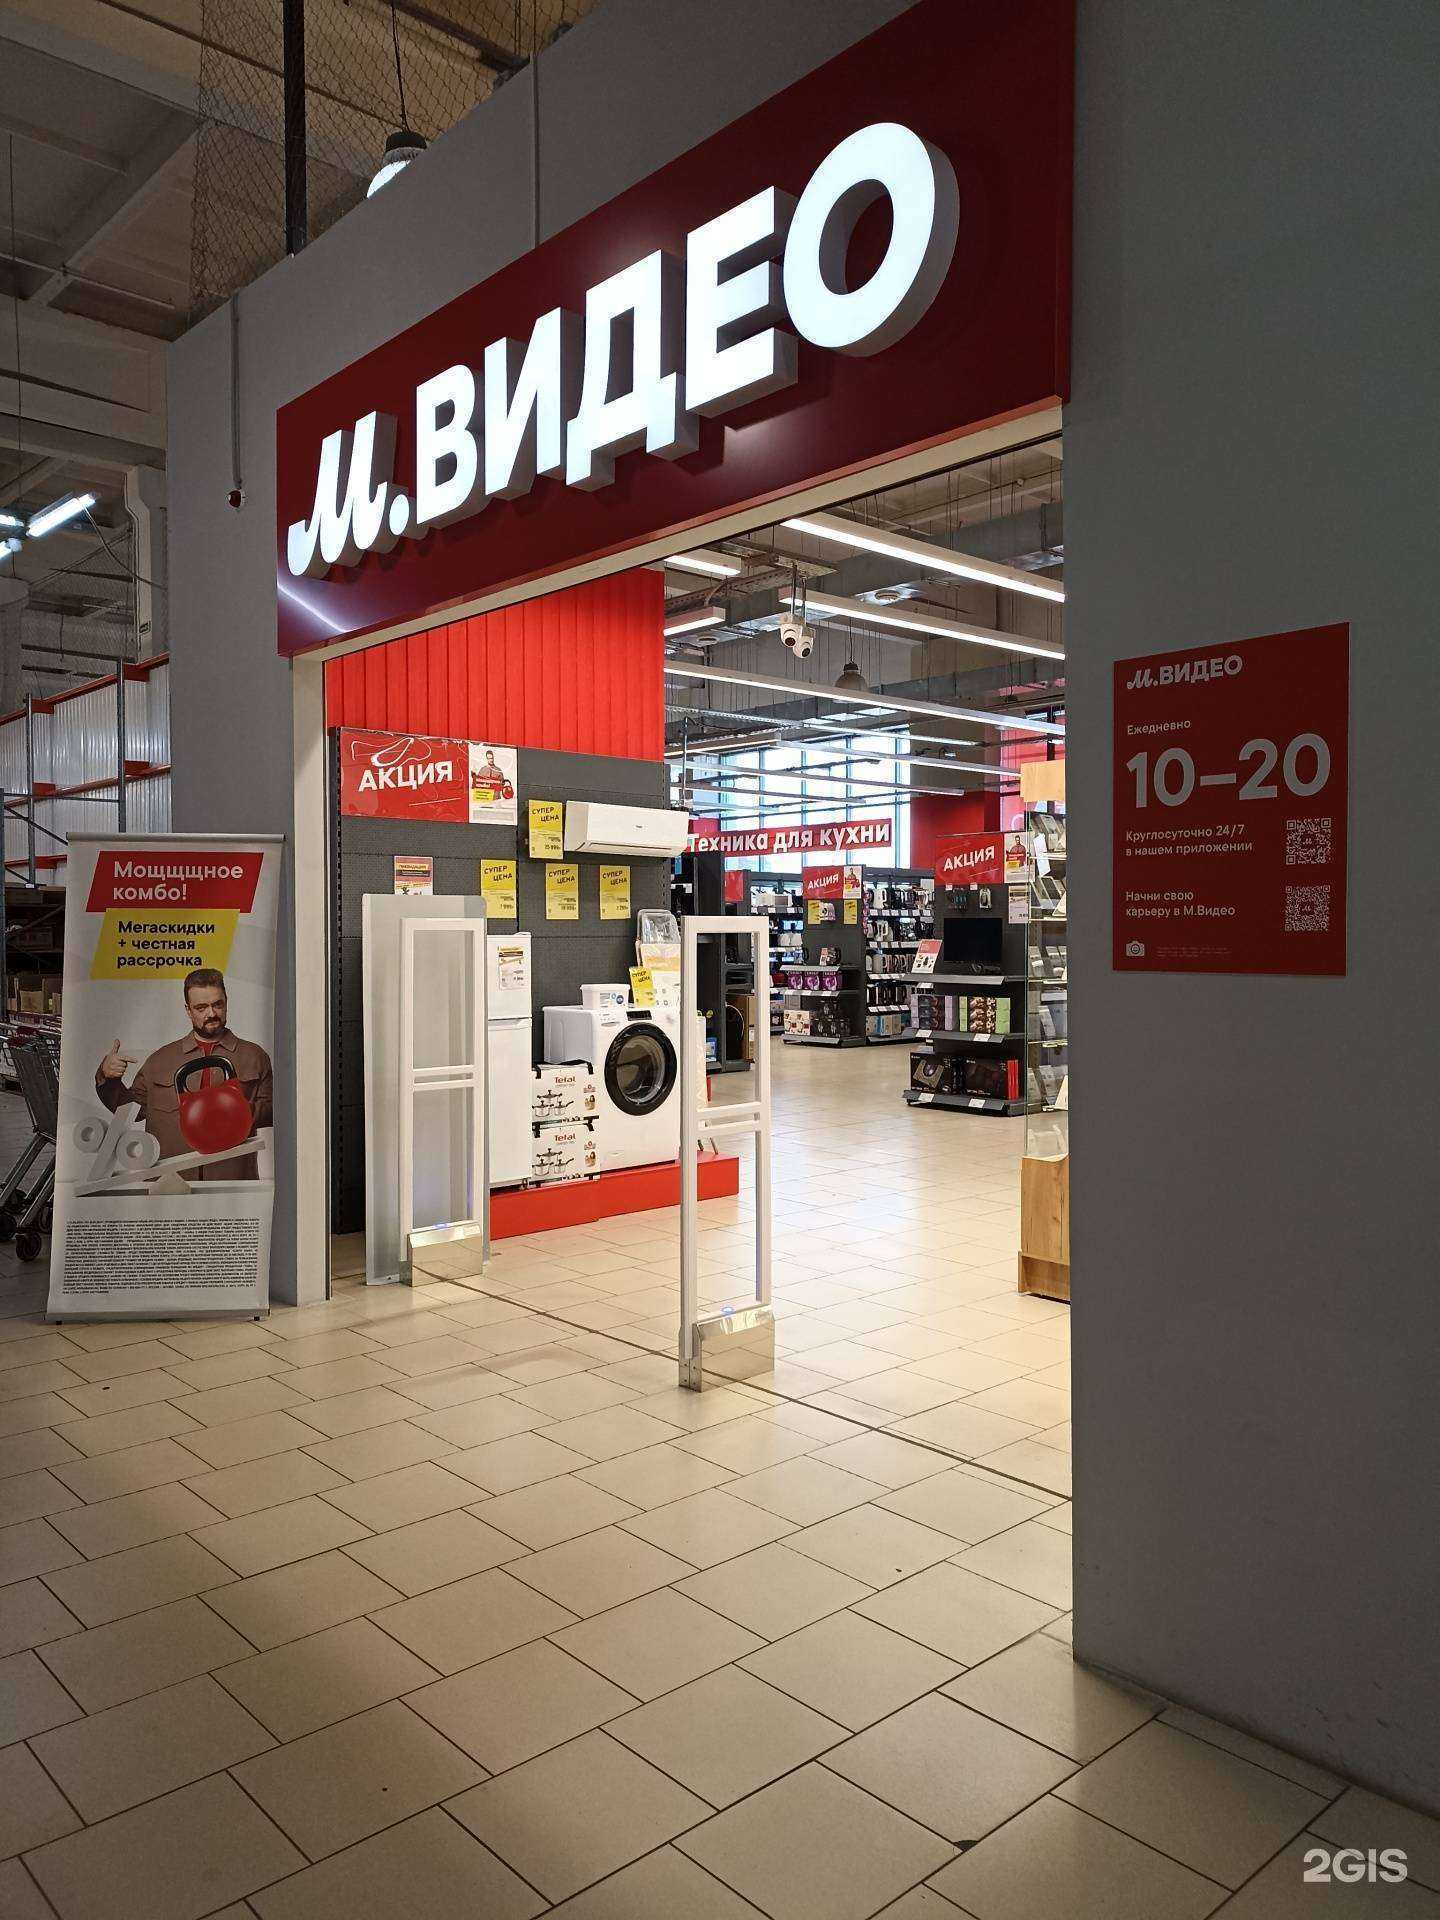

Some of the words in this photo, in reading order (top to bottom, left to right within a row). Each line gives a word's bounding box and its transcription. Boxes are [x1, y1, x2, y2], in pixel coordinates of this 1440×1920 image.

[288, 122, 938, 576] М.ВИДЕО
[1126, 654, 1244, 690] М.ВИДЕО
[1127, 720, 1191, 735] Ежедневно
[358, 761, 453, 792] АКЦИЯ
[532, 806, 555, 814] СУПЕР
[541, 814, 559, 822] ЦЕНА
[688, 832, 768, 852] Техника
[773, 829, 812, 853] для
[820, 823, 890, 850] кухни
[1125, 828, 1213, 843] Круглосуточно
[1216, 824, 1245, 838] 24/7
[1134, 846, 1173, 855] нашем
[1176, 841, 1253, 856] приложении
[943, 845, 995, 872] АКЦИЯ
[113, 861, 243, 880] Мощщщное
[484, 866, 507, 874] СУПЕР
[493, 873, 512, 881] ЦЕНА
[549, 869, 570, 877] СУПЕР
[602, 870, 623, 878] СУПЕР
[557, 876, 575, 884] ЦЕНА
[807, 873, 839, 890] АКЦИЯ
[112, 884, 187, 901] комбо!
[1125, 891, 1161, 901] Начни
[1163, 892, 1194, 901] свою
[1125, 908, 1171, 918] карьеру
[1183, 905, 1236, 917] М.Видео
[118, 920, 215, 935] Мегаскидки
[132, 939, 196, 951] честная
[117, 956, 202, 969] рассрочка
